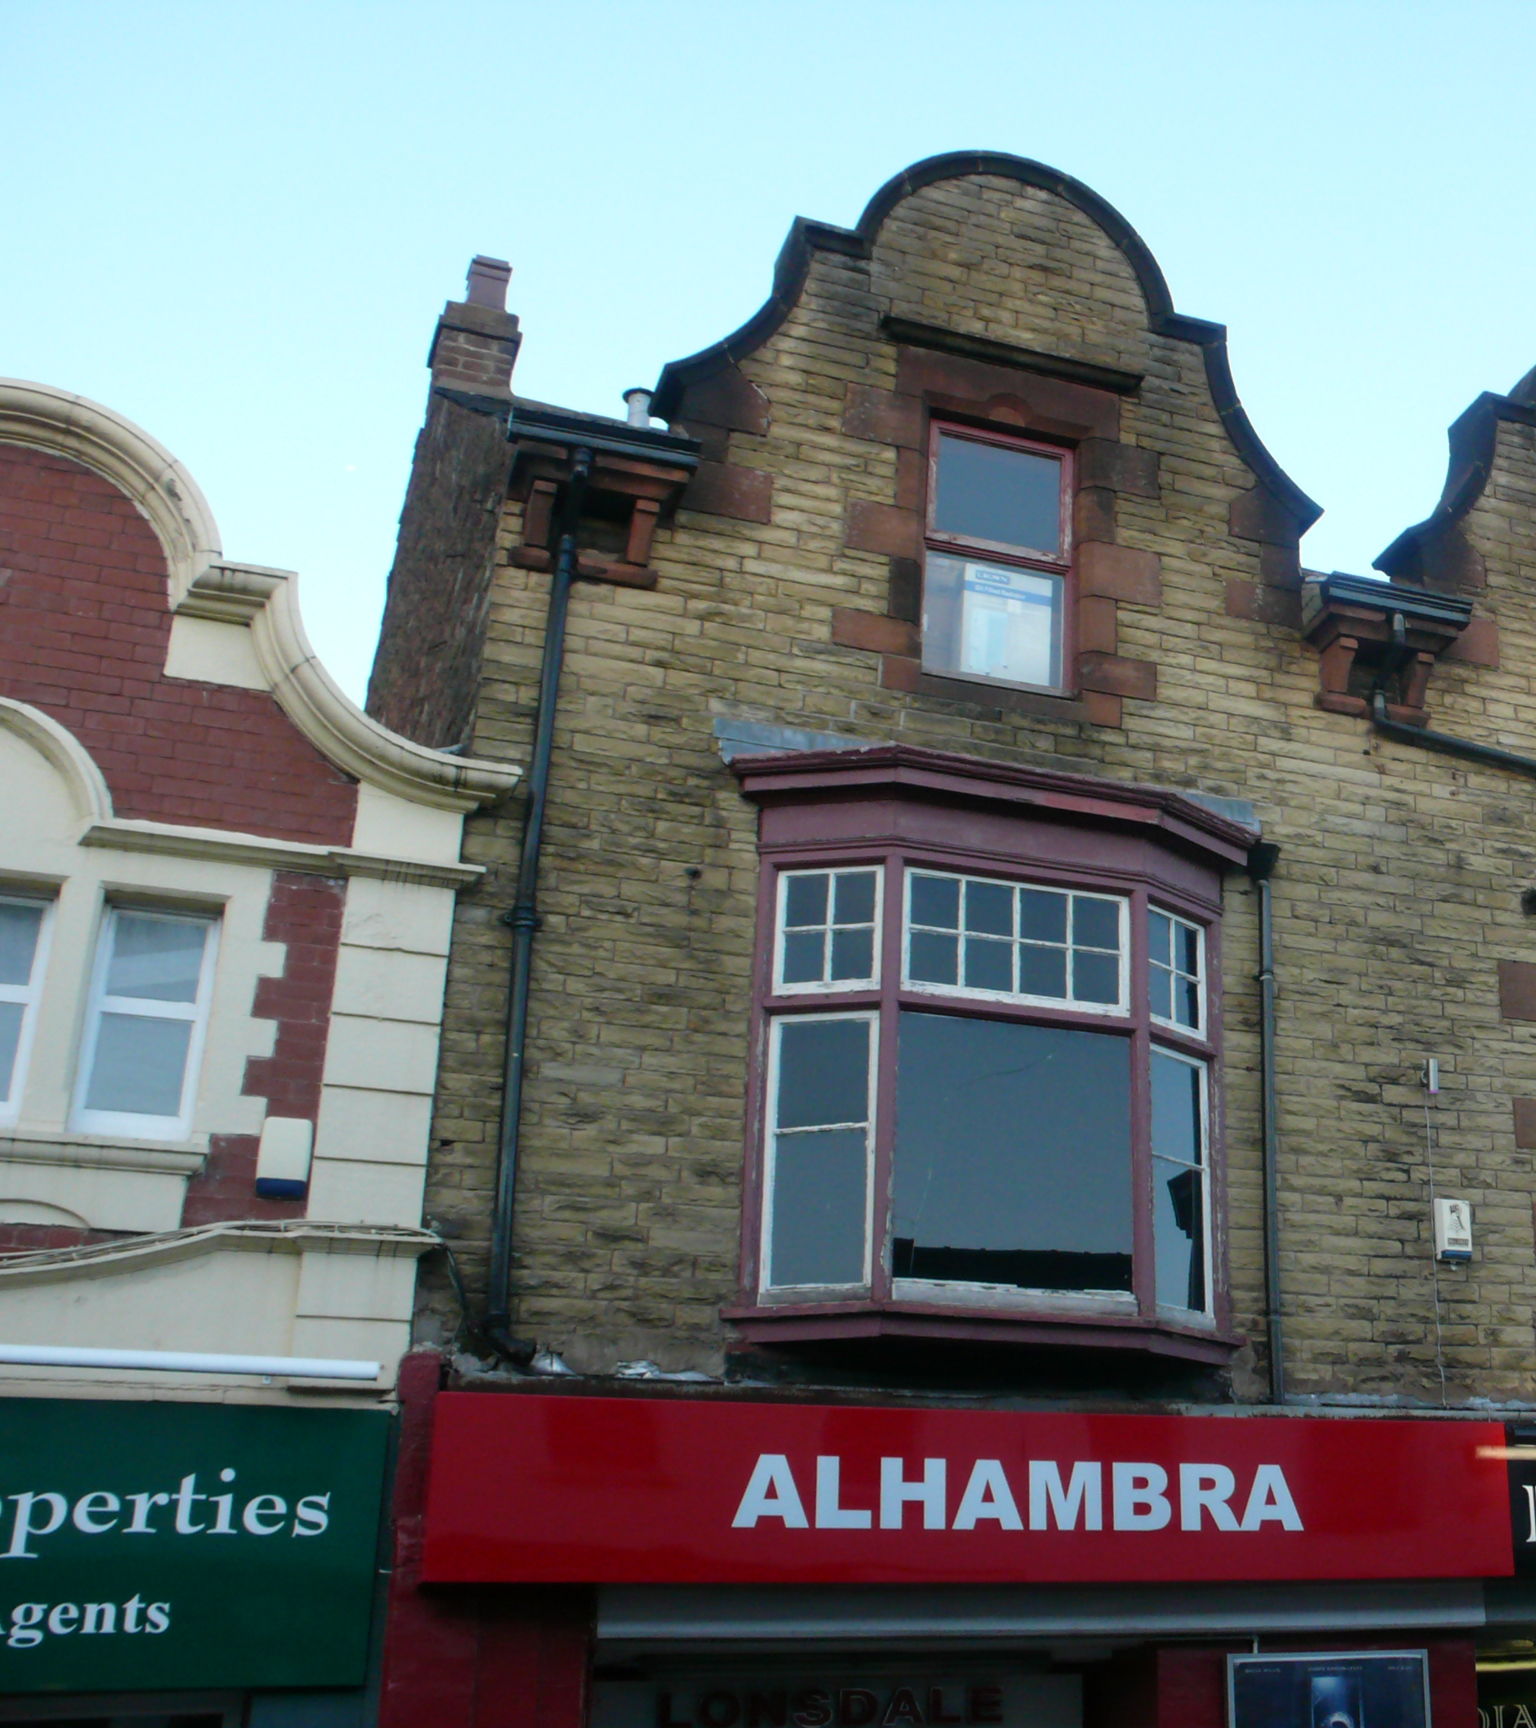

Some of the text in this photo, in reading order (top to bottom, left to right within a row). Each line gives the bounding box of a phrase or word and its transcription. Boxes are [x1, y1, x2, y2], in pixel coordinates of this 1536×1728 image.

[0, 1467, 331, 1558] perties
[730, 1453, 1304, 1532] ALHAMBRA
[0, 1593, 171, 1648] gents
[656, 1685, 1004, 1728] LONSDALE
